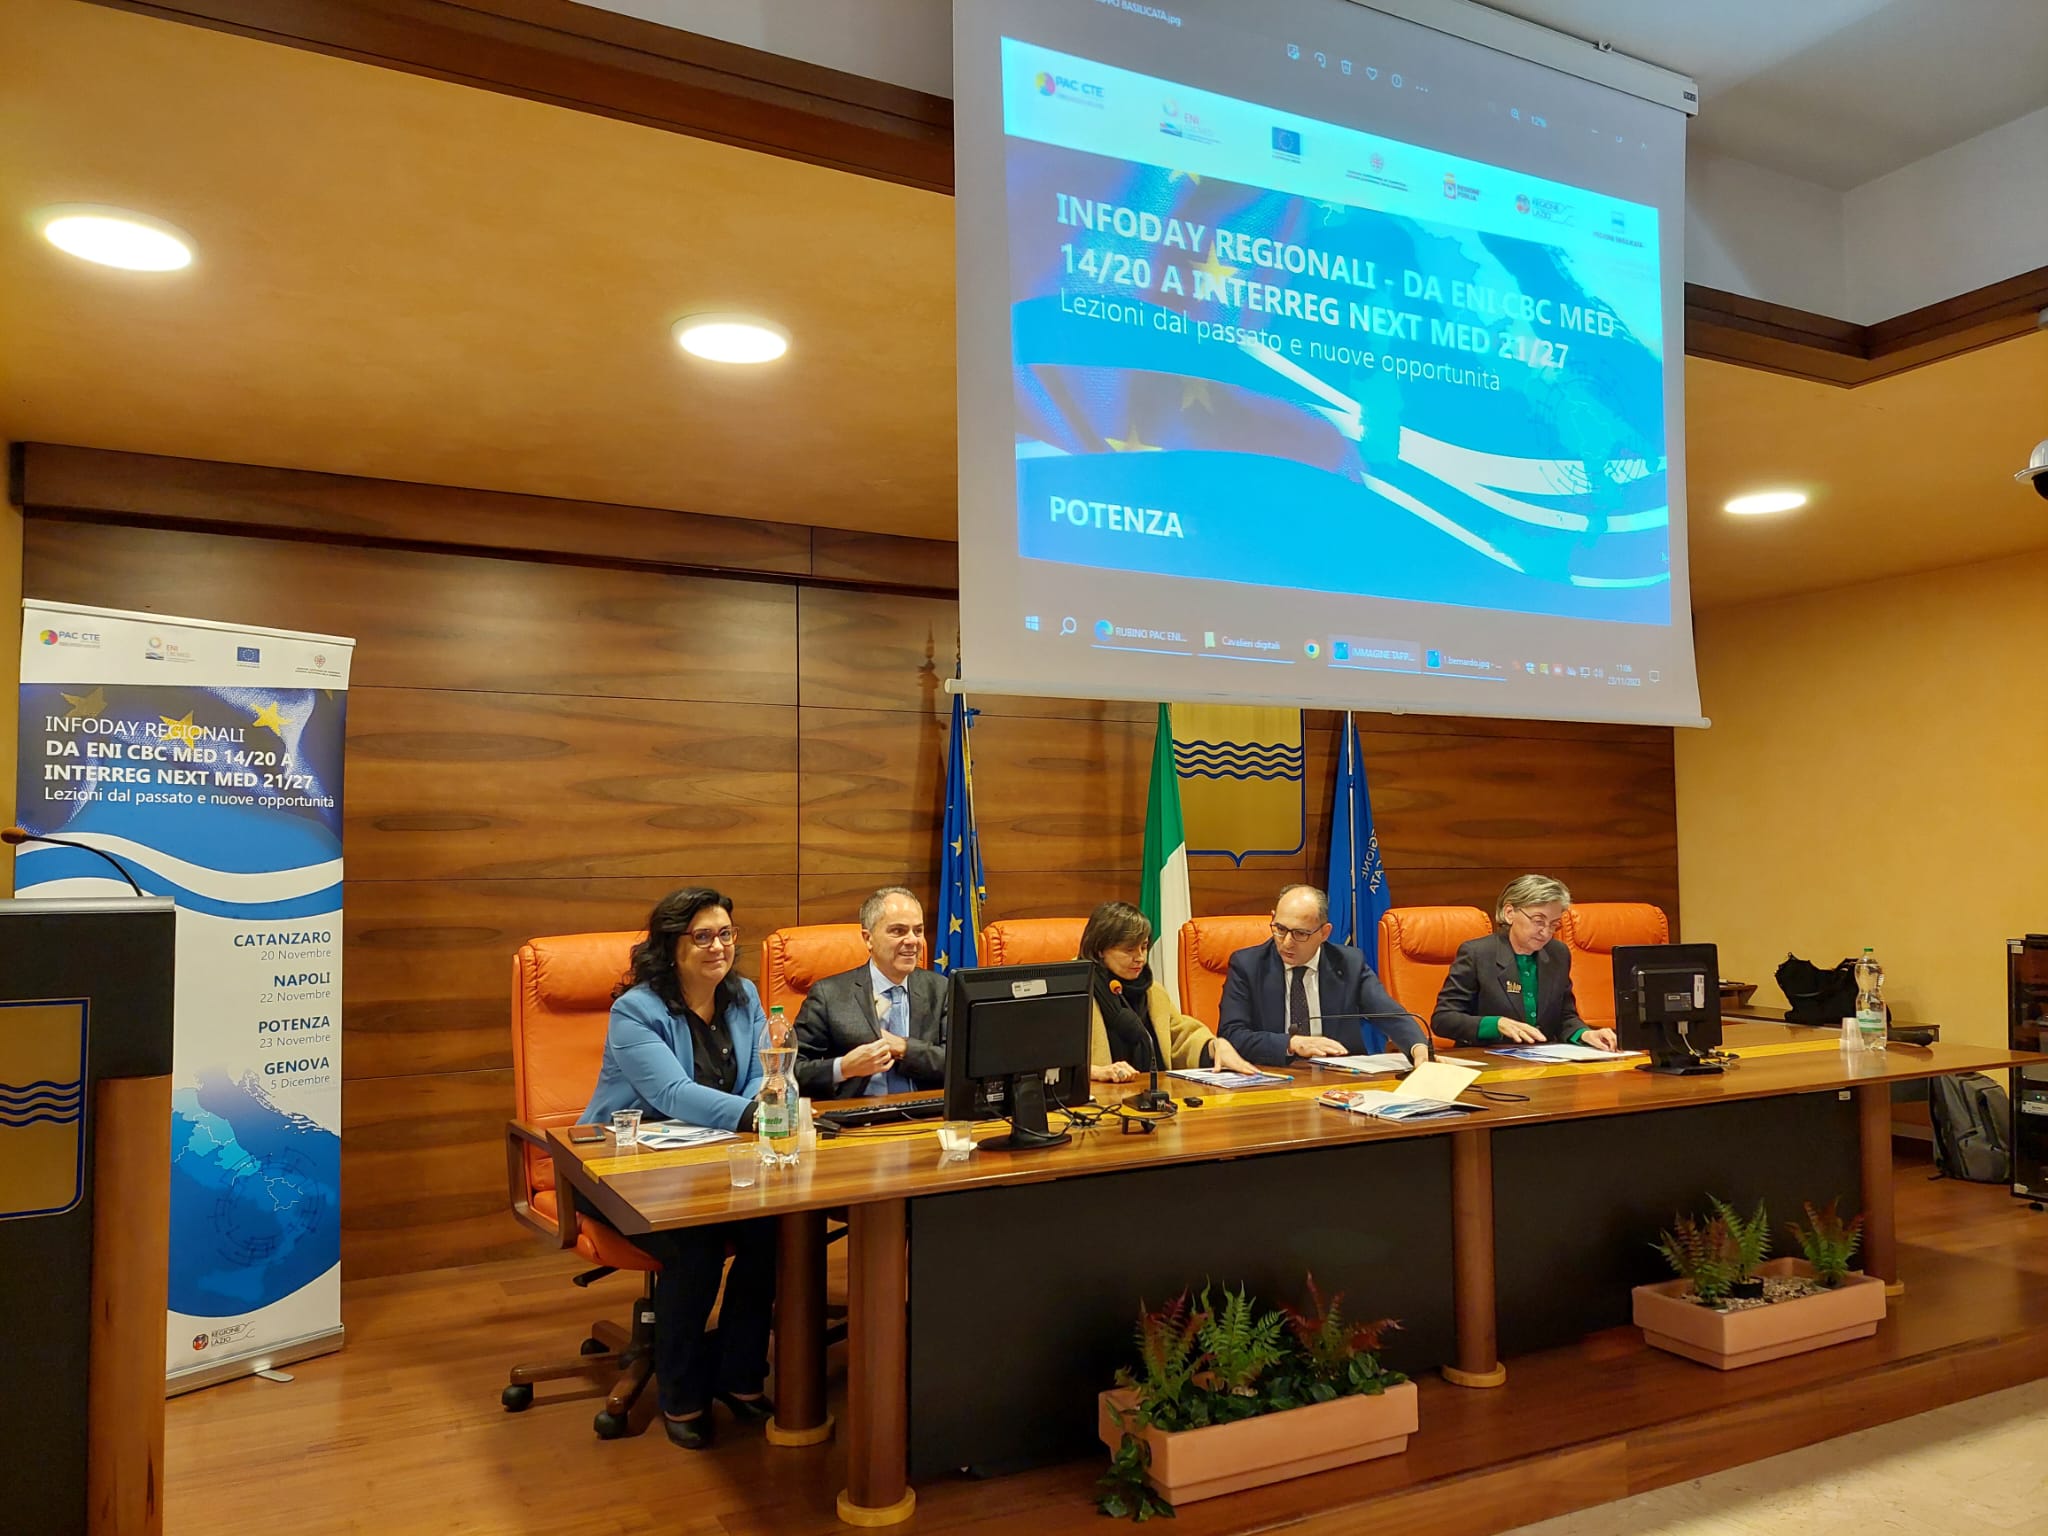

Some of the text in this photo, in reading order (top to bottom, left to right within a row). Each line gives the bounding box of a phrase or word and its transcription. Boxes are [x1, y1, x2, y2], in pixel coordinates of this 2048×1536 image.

[1055, 76, 1104, 98] PAC CTE
[1056, 192, 1206, 253] INFODAY
[1215, 228, 1376, 290] REGIONALI
[1403, 269, 1444, 304] DA
[1451, 280, 1497, 315] ENI
[1502, 291, 1552, 325] CBC
[1560, 303, 1614, 337] MED
[1060, 243, 1569, 370] 14/20 A INTERREG NEXT MED 21/27
[1060, 287, 1501, 392] Lezioni dal passato e nuove opportunità
[1050, 495, 1185, 539] POTENZA
[59, 630, 101, 642] PAC CTE
[45, 715, 245, 743] INFODAY REGIONALI
[46, 740, 294, 768] DA ENI CBC MED 14/20 A
[44, 764, 313, 791] INTERREG NEXT MED 21/27
[45, 786, 334, 809] Lezioni dal passato e nuove opportunità
[234, 931, 331, 948] CATANZARO
[261, 948, 331, 961] 20 Novembre
[274, 972, 331, 988] NAPOLI
[260, 989, 331, 1003] 22 Novembre
[258, 1015, 331, 1034] POTENZA
[259, 1033, 331, 1048] 23 Novembre
[264, 1056, 330, 1075] GENOVA
[271, 1074, 331, 1090] 5 Dicembre
[211, 1324, 241, 1338] REGIONE
[211, 1336, 231, 1347] LAZIO
